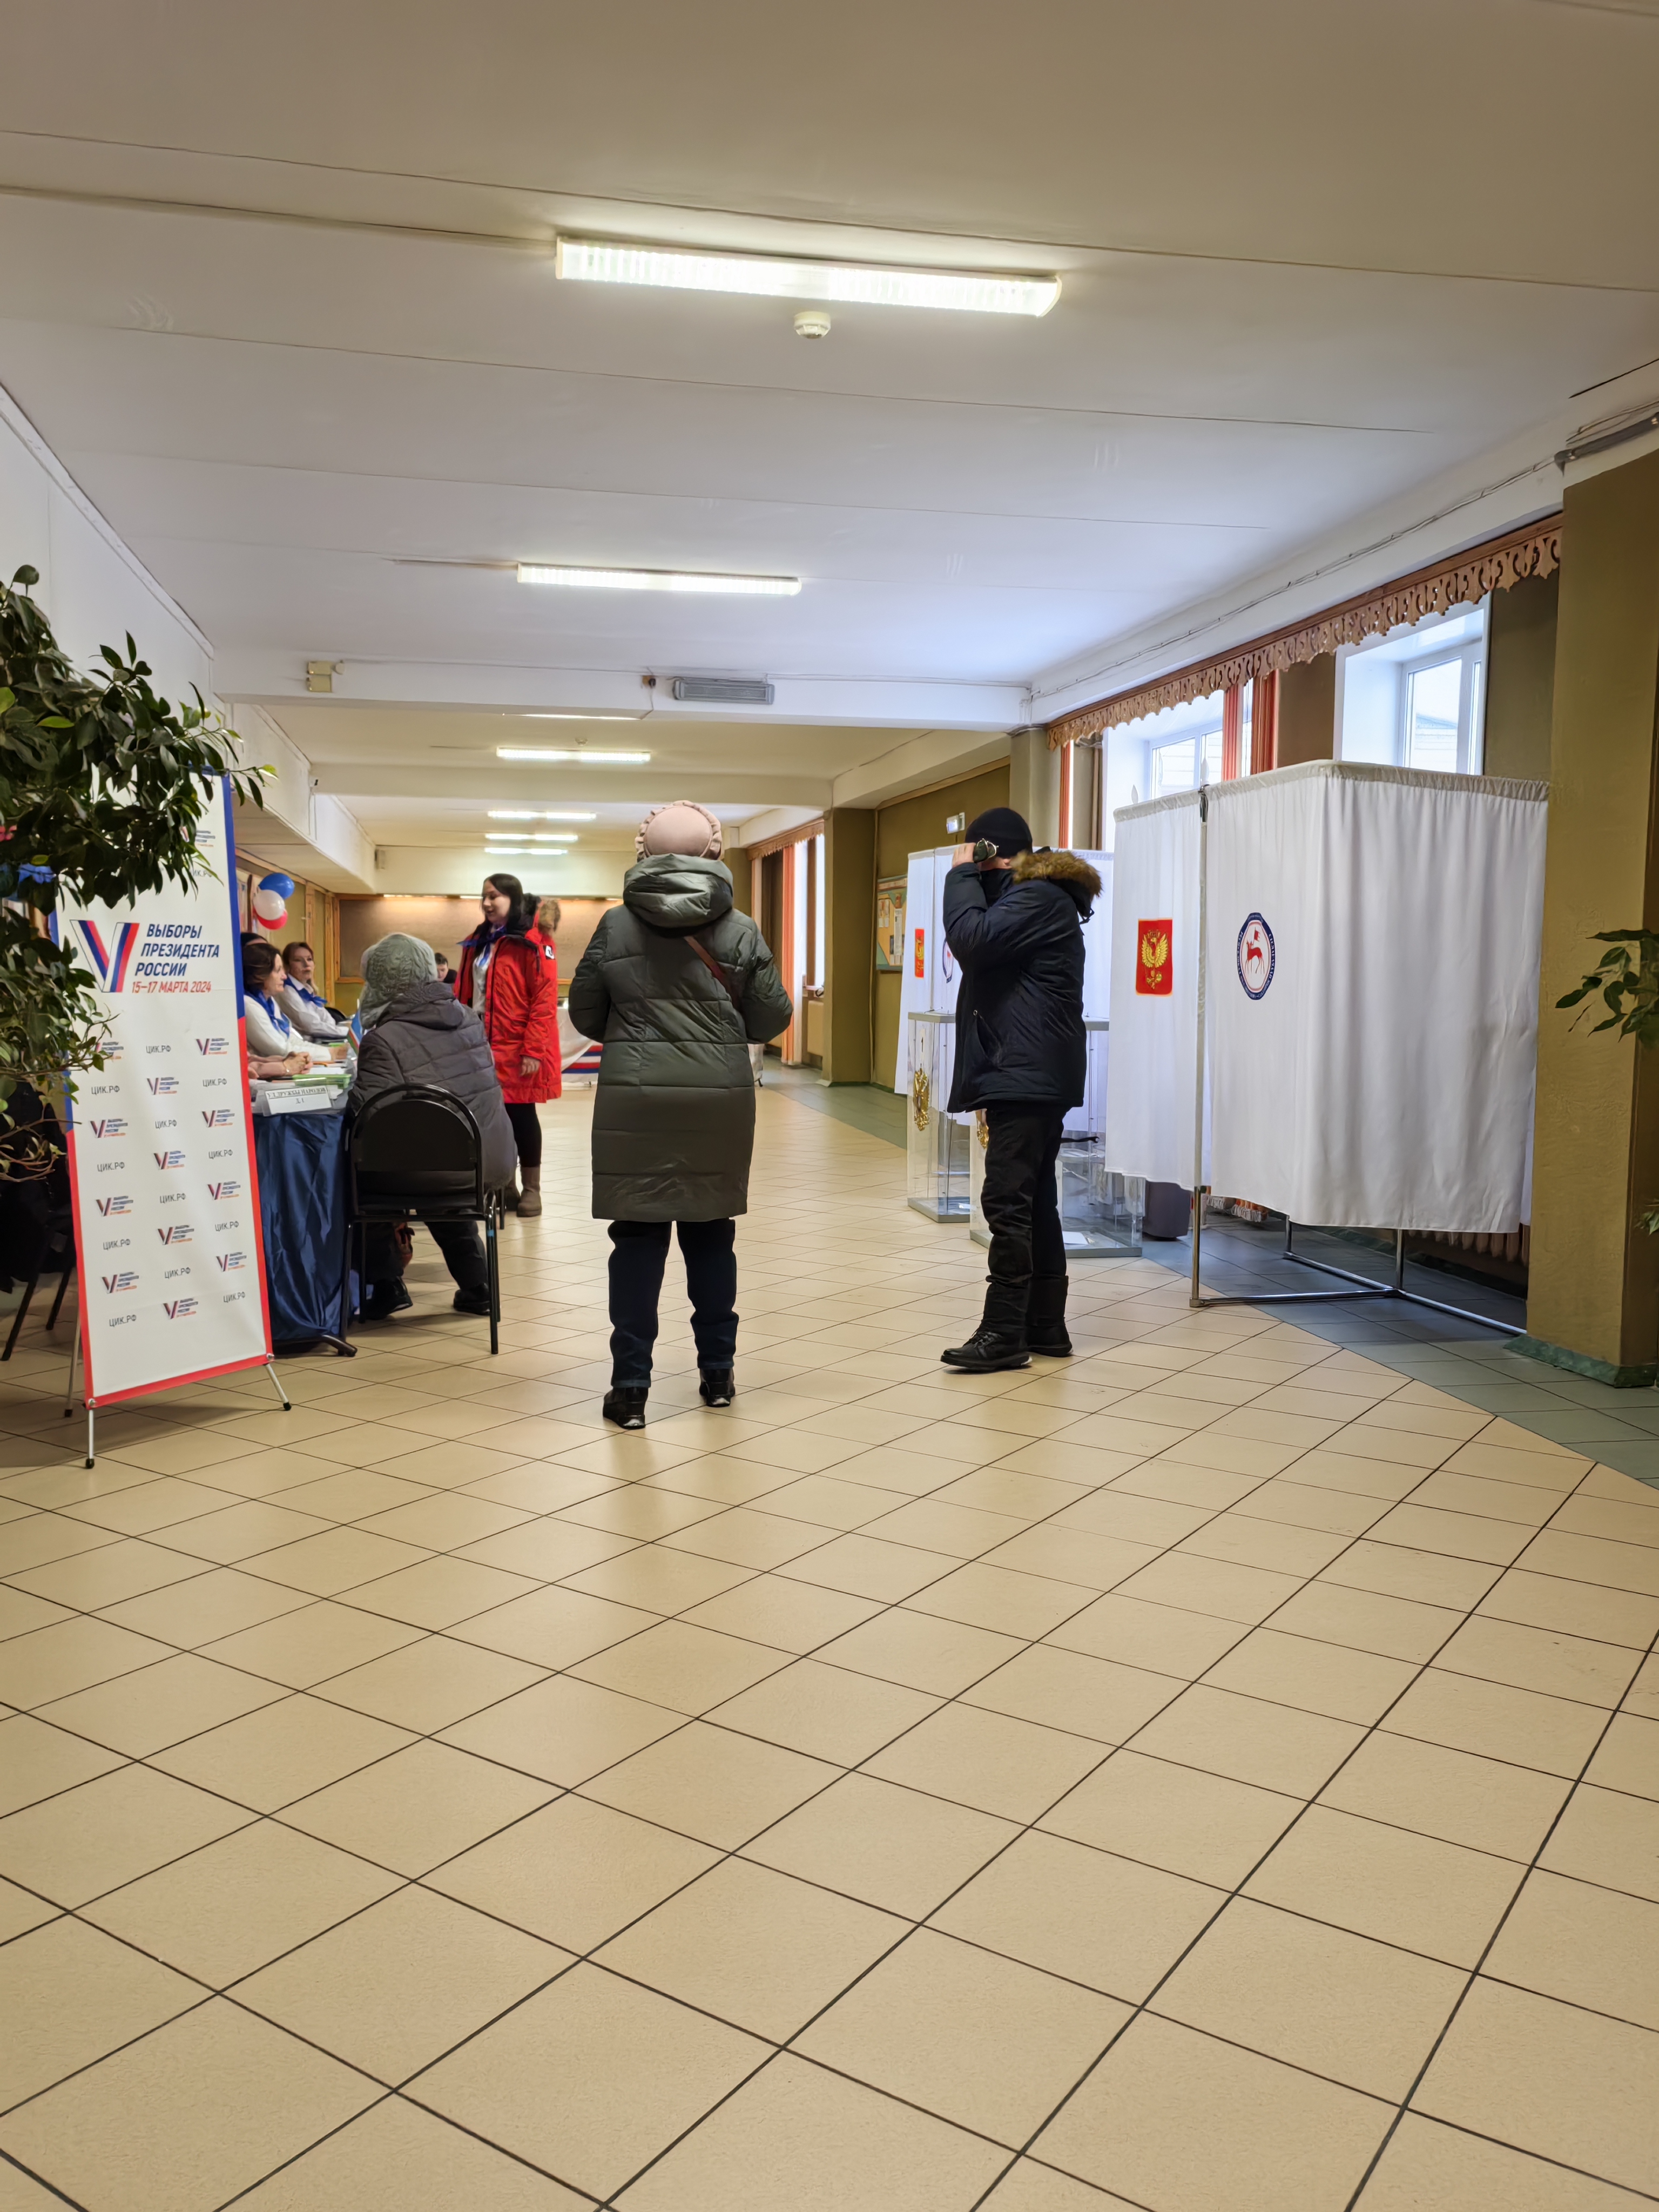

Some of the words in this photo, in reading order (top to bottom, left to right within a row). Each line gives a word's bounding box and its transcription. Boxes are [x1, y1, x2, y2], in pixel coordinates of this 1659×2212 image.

[146, 923, 203, 939] ВЫБОРЫ
[140, 943, 220, 959] ПРЕЗИДЕНТА
[134, 962, 188, 976] РОССИИ
[158, 981, 189, 993] МАРТА
[190, 981, 212, 993] 2024
[146, 1045, 171, 1054] ЦИК.РФ
[203, 1078, 227, 1087] ЦИК.РФ
[91, 1085, 120, 1095] ЦИК.РФ
[155, 1120, 177, 1129] ЦИК.РФ
[208, 1149, 233, 1159] ЦИК.РФ
[97, 1162, 125, 1172] ЦИК.РФ
[159, 1193, 186, 1204] ЦИК.РФ
[214, 1220, 239, 1231] ЦИК.РФ
[103, 1238, 131, 1250] ЦИК.РФ
[165, 1267, 191, 1279] ЦИК.РФ
[223, 1291, 246, 1303] ЦИК.РФ
[109, 1314, 137, 1327] ЦИК.РФ
